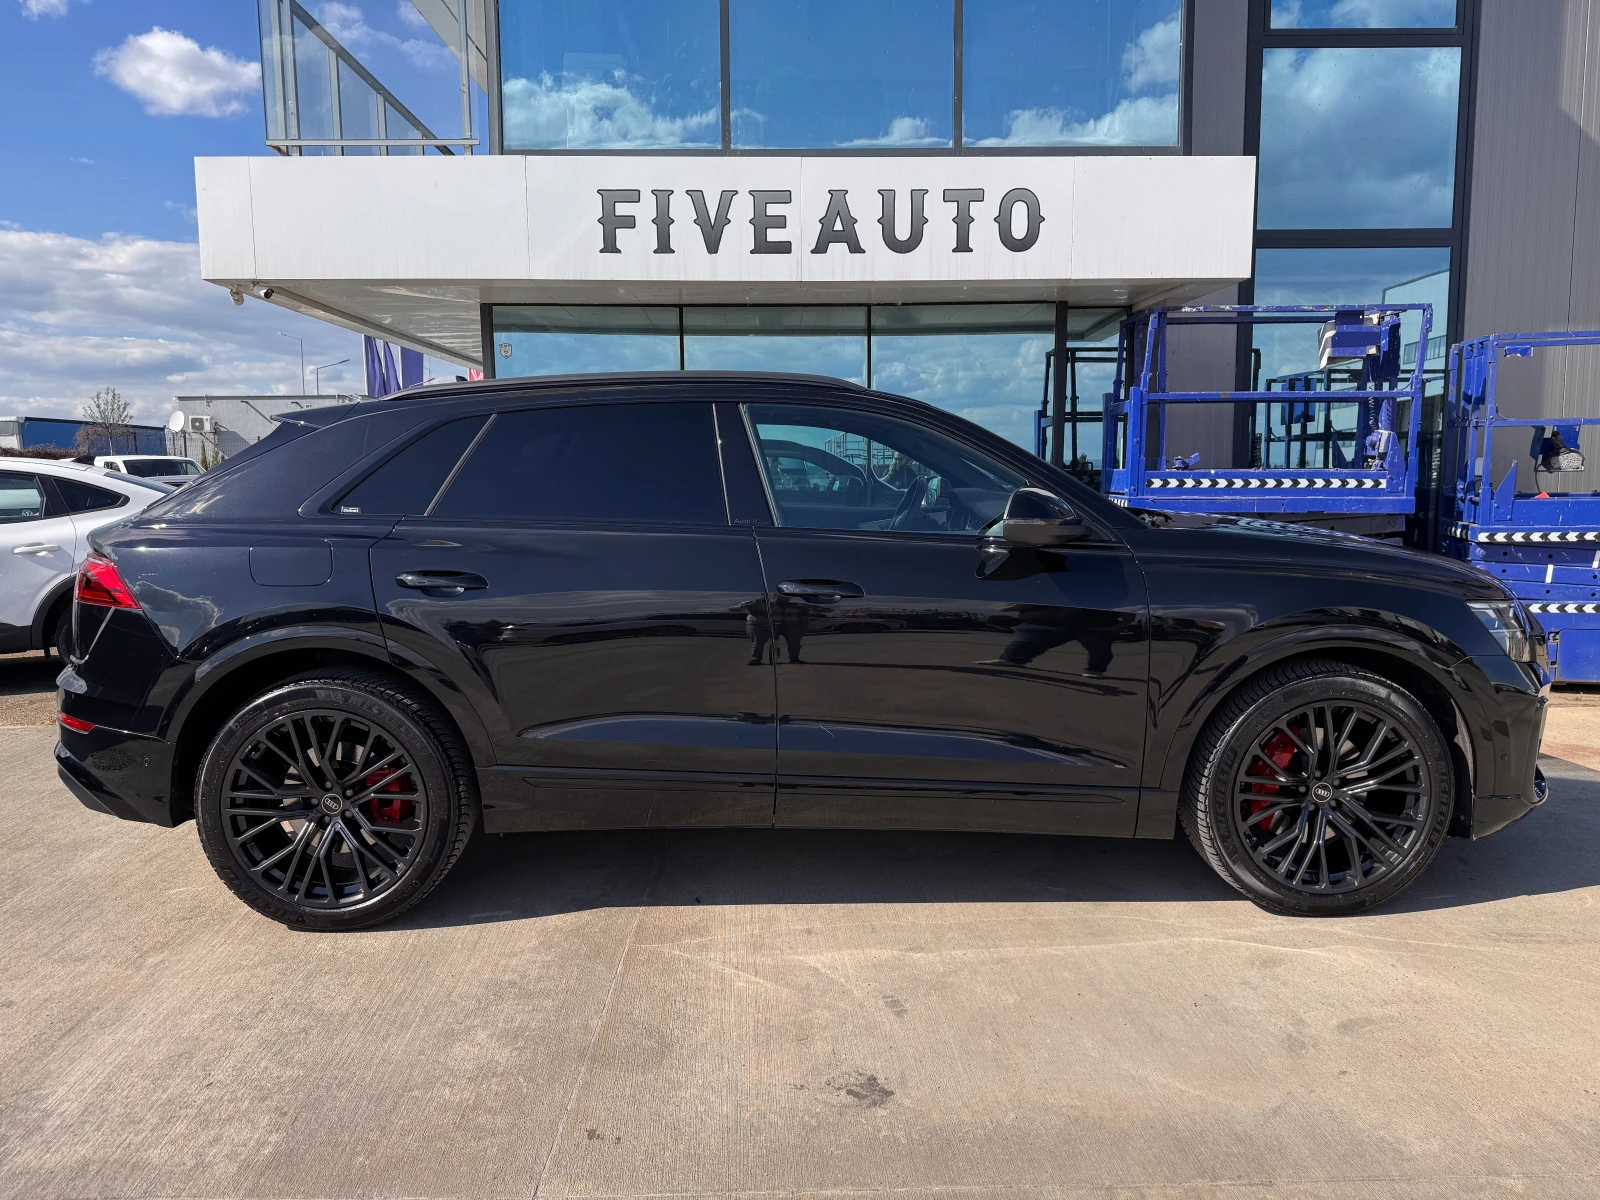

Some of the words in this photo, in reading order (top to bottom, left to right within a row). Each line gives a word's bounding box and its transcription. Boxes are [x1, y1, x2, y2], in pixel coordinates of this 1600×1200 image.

[347, 694, 430, 755] MICHELIN
[1215, 751, 1236, 837] MICHELIN
[1429, 760, 1448, 843] MICHELIN
